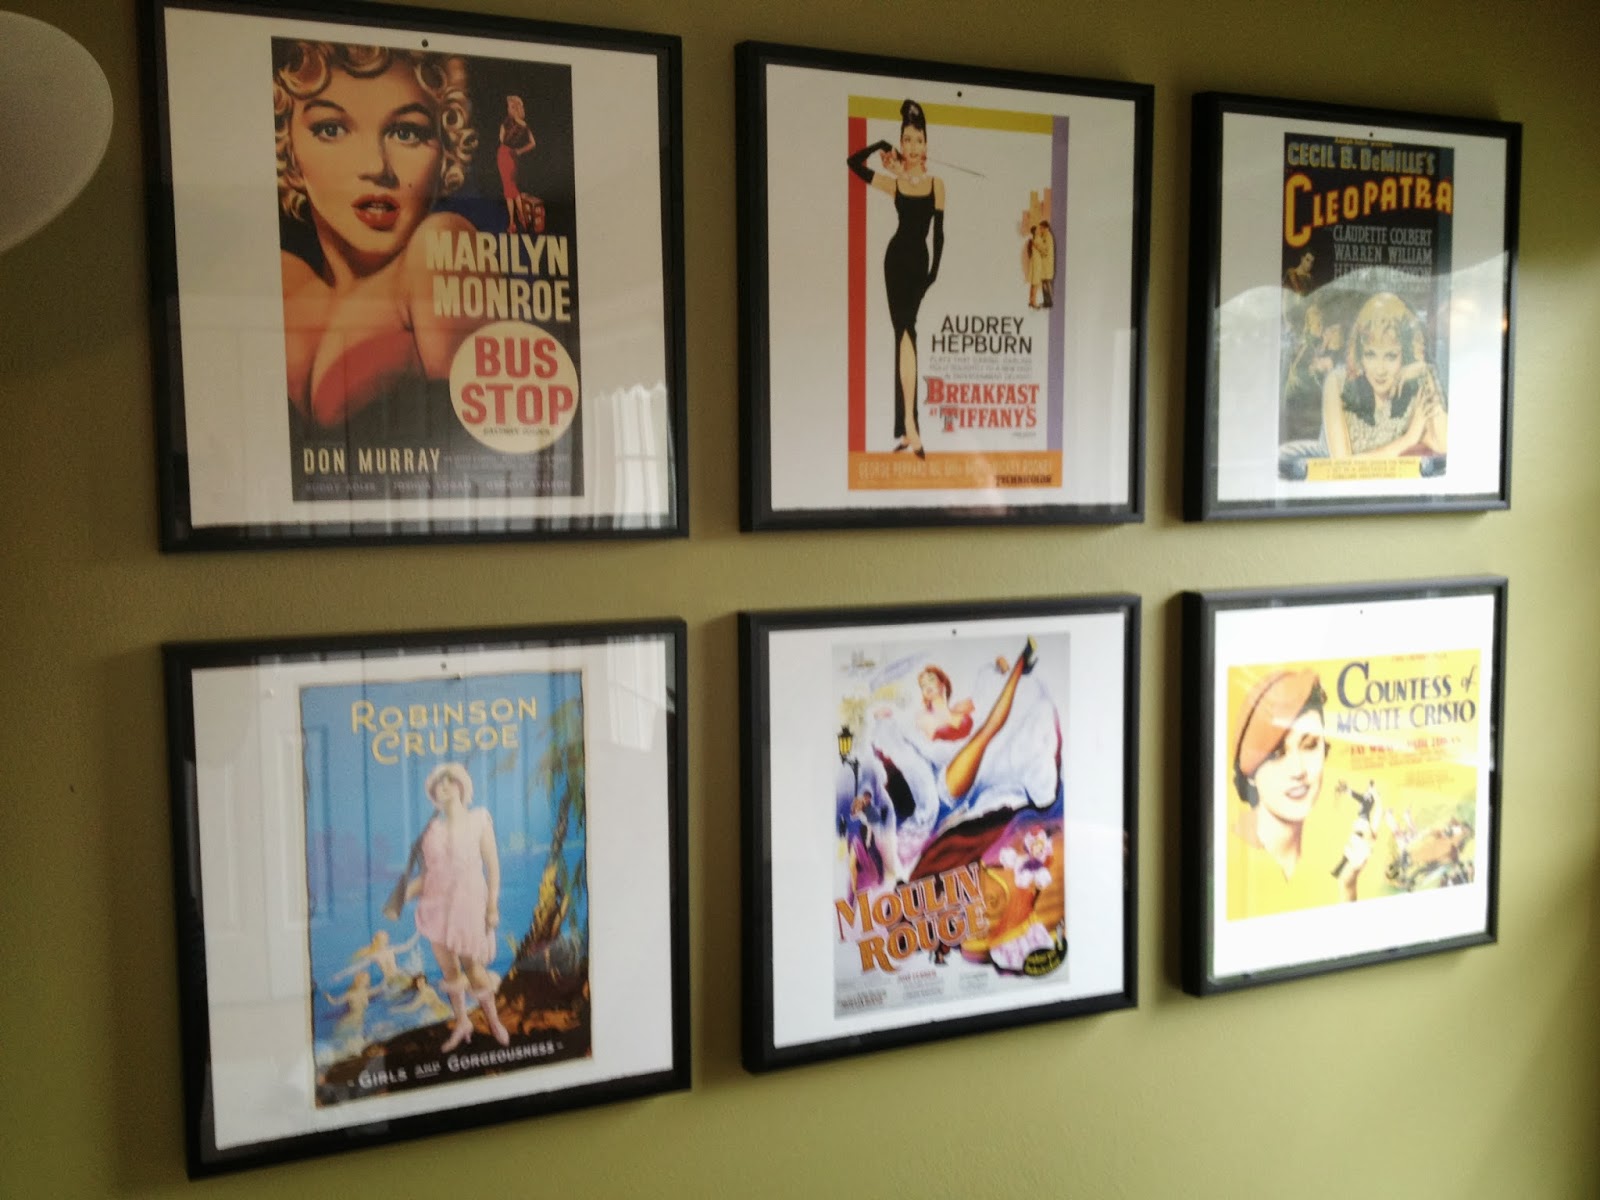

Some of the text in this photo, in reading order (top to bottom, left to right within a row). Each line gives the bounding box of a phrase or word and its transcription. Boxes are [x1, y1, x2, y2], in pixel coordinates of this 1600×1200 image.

[1287, 142, 1335, 168] CECIL
[1284, 172, 1453, 247] CLEOPATRA
[425, 230, 569, 277] MARILYN
[1332, 225, 1433, 246] CLAUDETTE COLBERT
[1334, 244, 1433, 265] WARREN WILLIAM
[432, 275, 571, 322] MONROE
[931, 335, 1033, 354] HEPBURN
[940, 314, 1024, 336] AUDREY
[474, 335, 558, 379] BUS
[460, 383, 574, 426] STOP
[923, 375, 1040, 405] BREAKFAST
[304, 448, 441, 475] DON MURRAY
[1336, 661, 1478, 709] COUNTESS of
[351, 695, 537, 734] ROBINSON
[1336, 699, 1477, 734] MONTE CRISTO
[371, 723, 520, 765] CRUSOE
[835, 862, 985, 943] MOULIN
[858, 903, 991, 974] ROUGE
[358, 1039, 556, 1090] GIRLS AND GORGEOUSNESS
